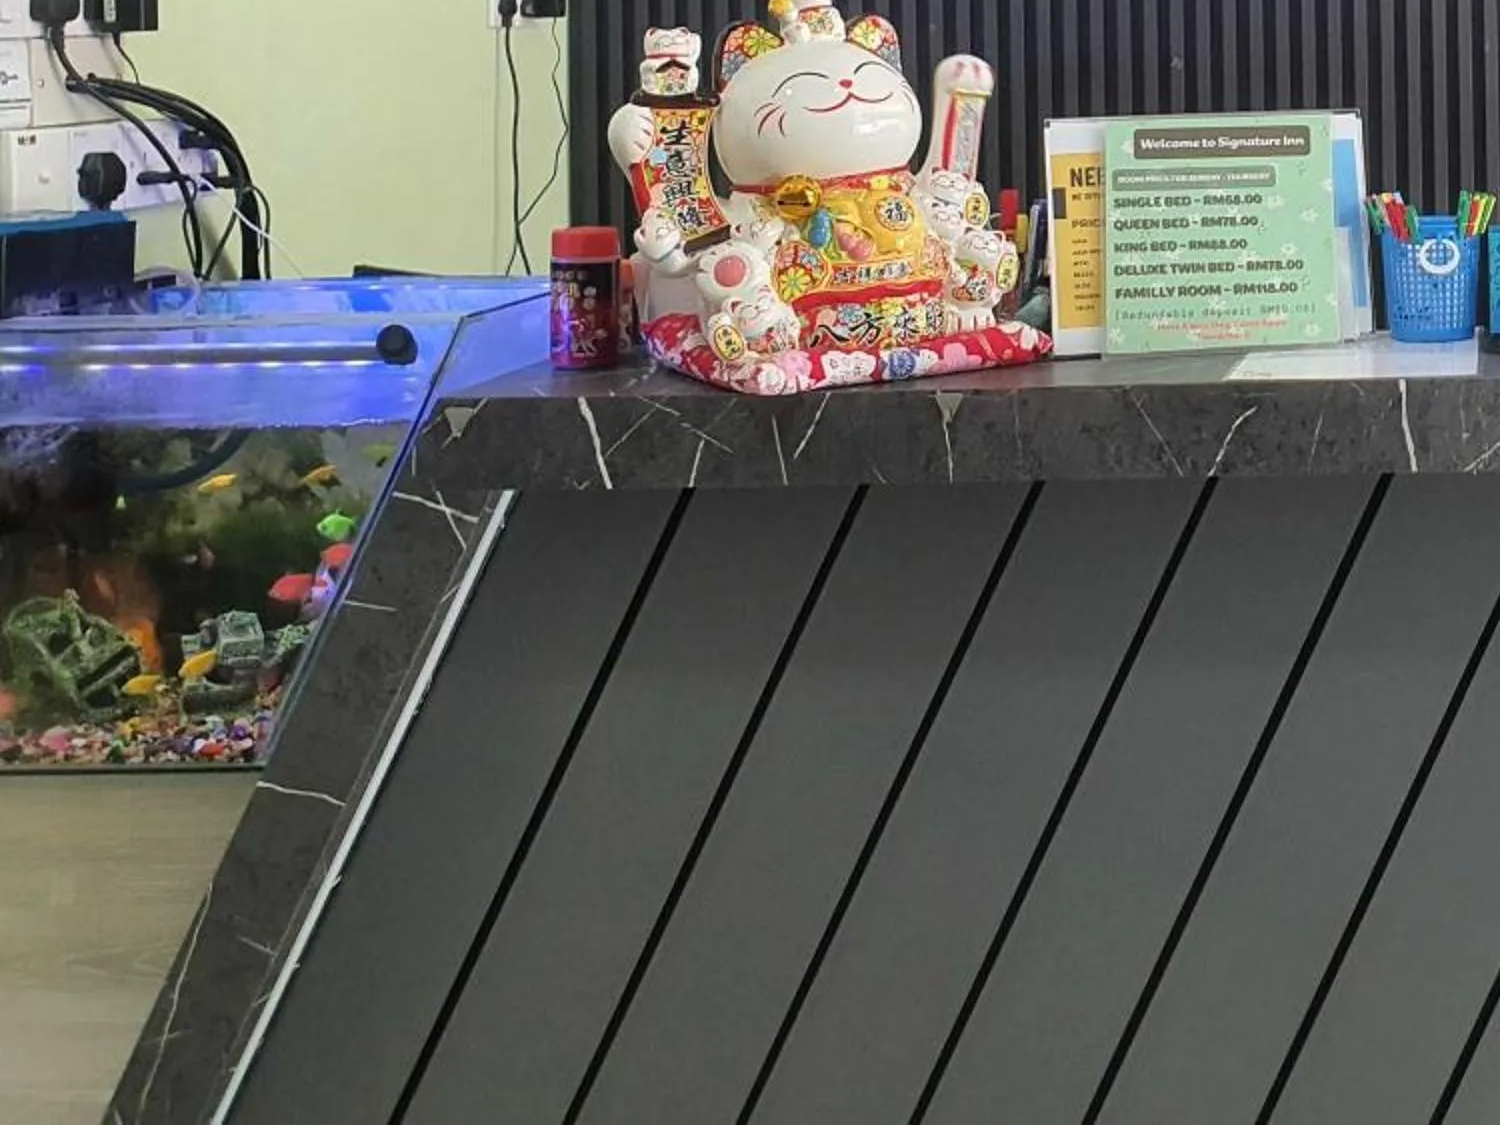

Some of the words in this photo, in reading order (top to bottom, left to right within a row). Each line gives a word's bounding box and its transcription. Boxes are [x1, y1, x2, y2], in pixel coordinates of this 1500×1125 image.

[1140, 138, 1200, 150] Welcome
[1202, 138, 1216, 148] to
[1217, 135, 1281, 150] Signature
[1284, 135, 1305, 146] Inn
[1114, 196, 1162, 208] SINGLE
[1164, 195, 1191, 207] BED
[1113, 218, 1161, 231] QUEEN
[1163, 217, 1190, 229] BED
[1114, 241, 1148, 253] KING
[1150, 240, 1178, 252] BED
[1113, 263, 1168, 276] DELUXE
[1170, 262, 1205, 274] TWIN
[1207, 261, 1235, 273] BED
[1115, 286, 1176, 299] FAMILLY
[1178, 284, 1222, 297] ROOM
